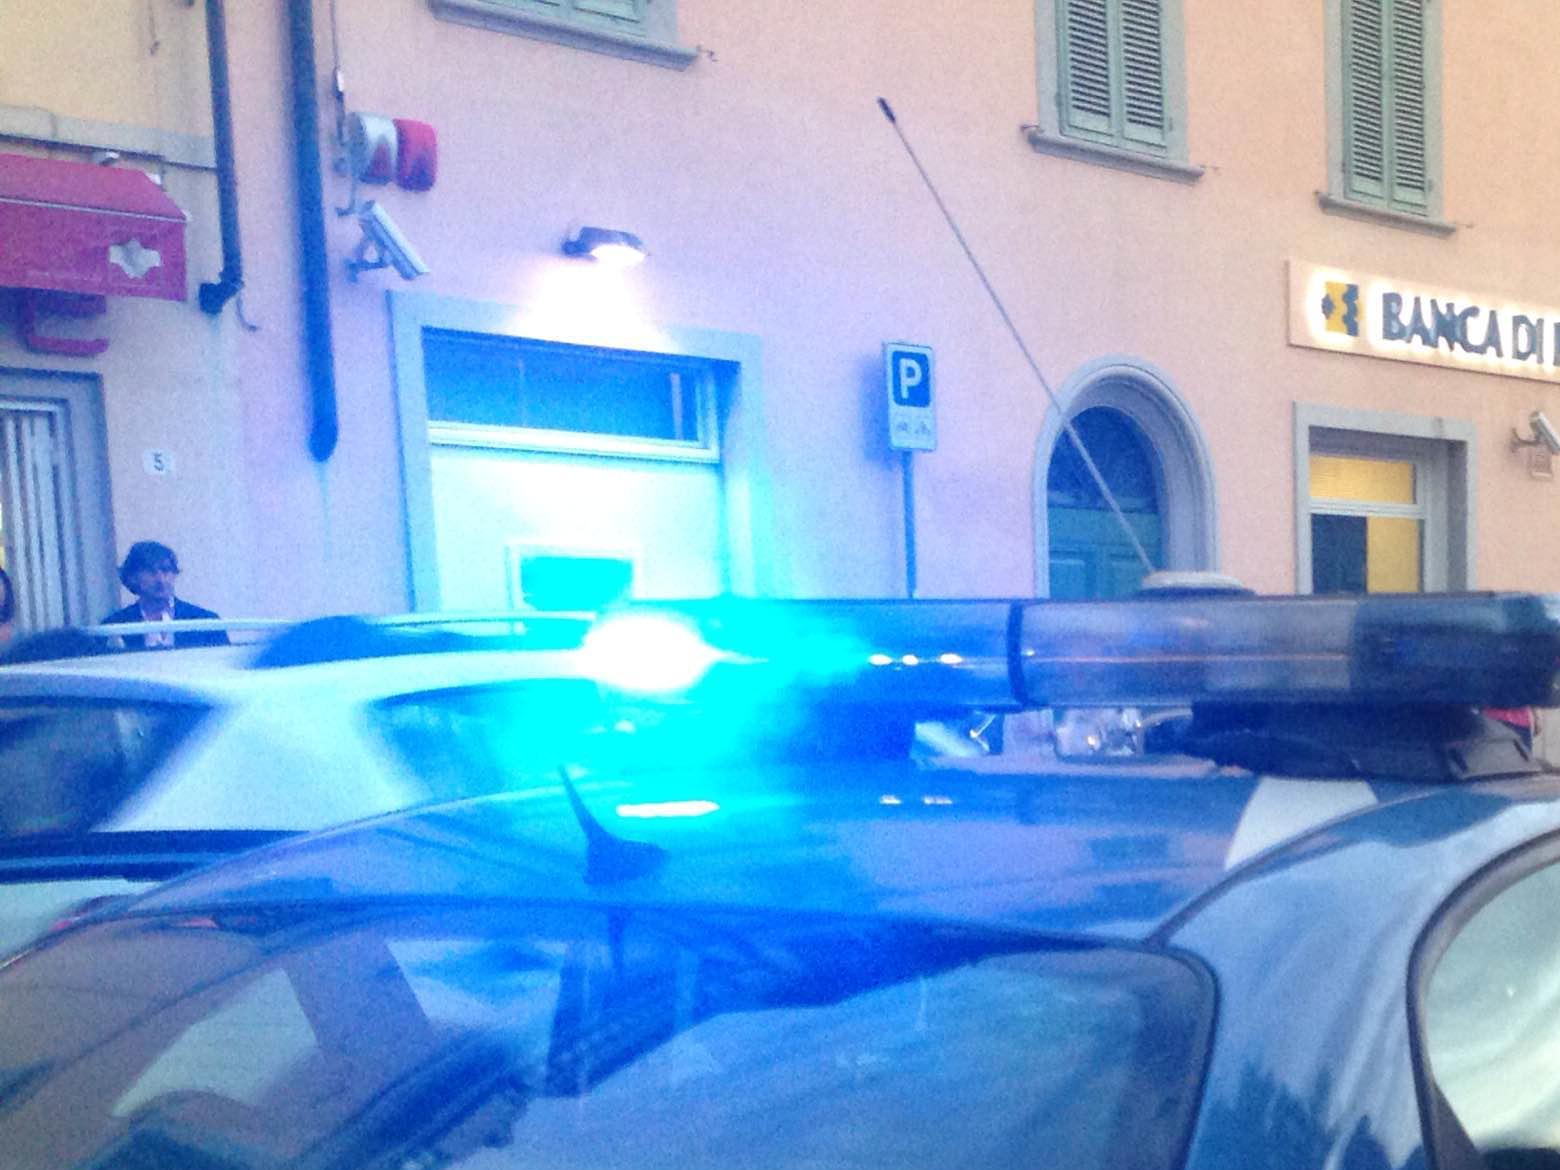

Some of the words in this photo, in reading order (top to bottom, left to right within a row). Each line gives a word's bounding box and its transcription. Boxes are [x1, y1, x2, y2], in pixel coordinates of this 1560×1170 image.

[1382, 292, 1504, 358] BANCA
[1512, 315, 1544, 364] DI
[900, 358, 922, 399] P
[153, 452, 165, 472] 5
